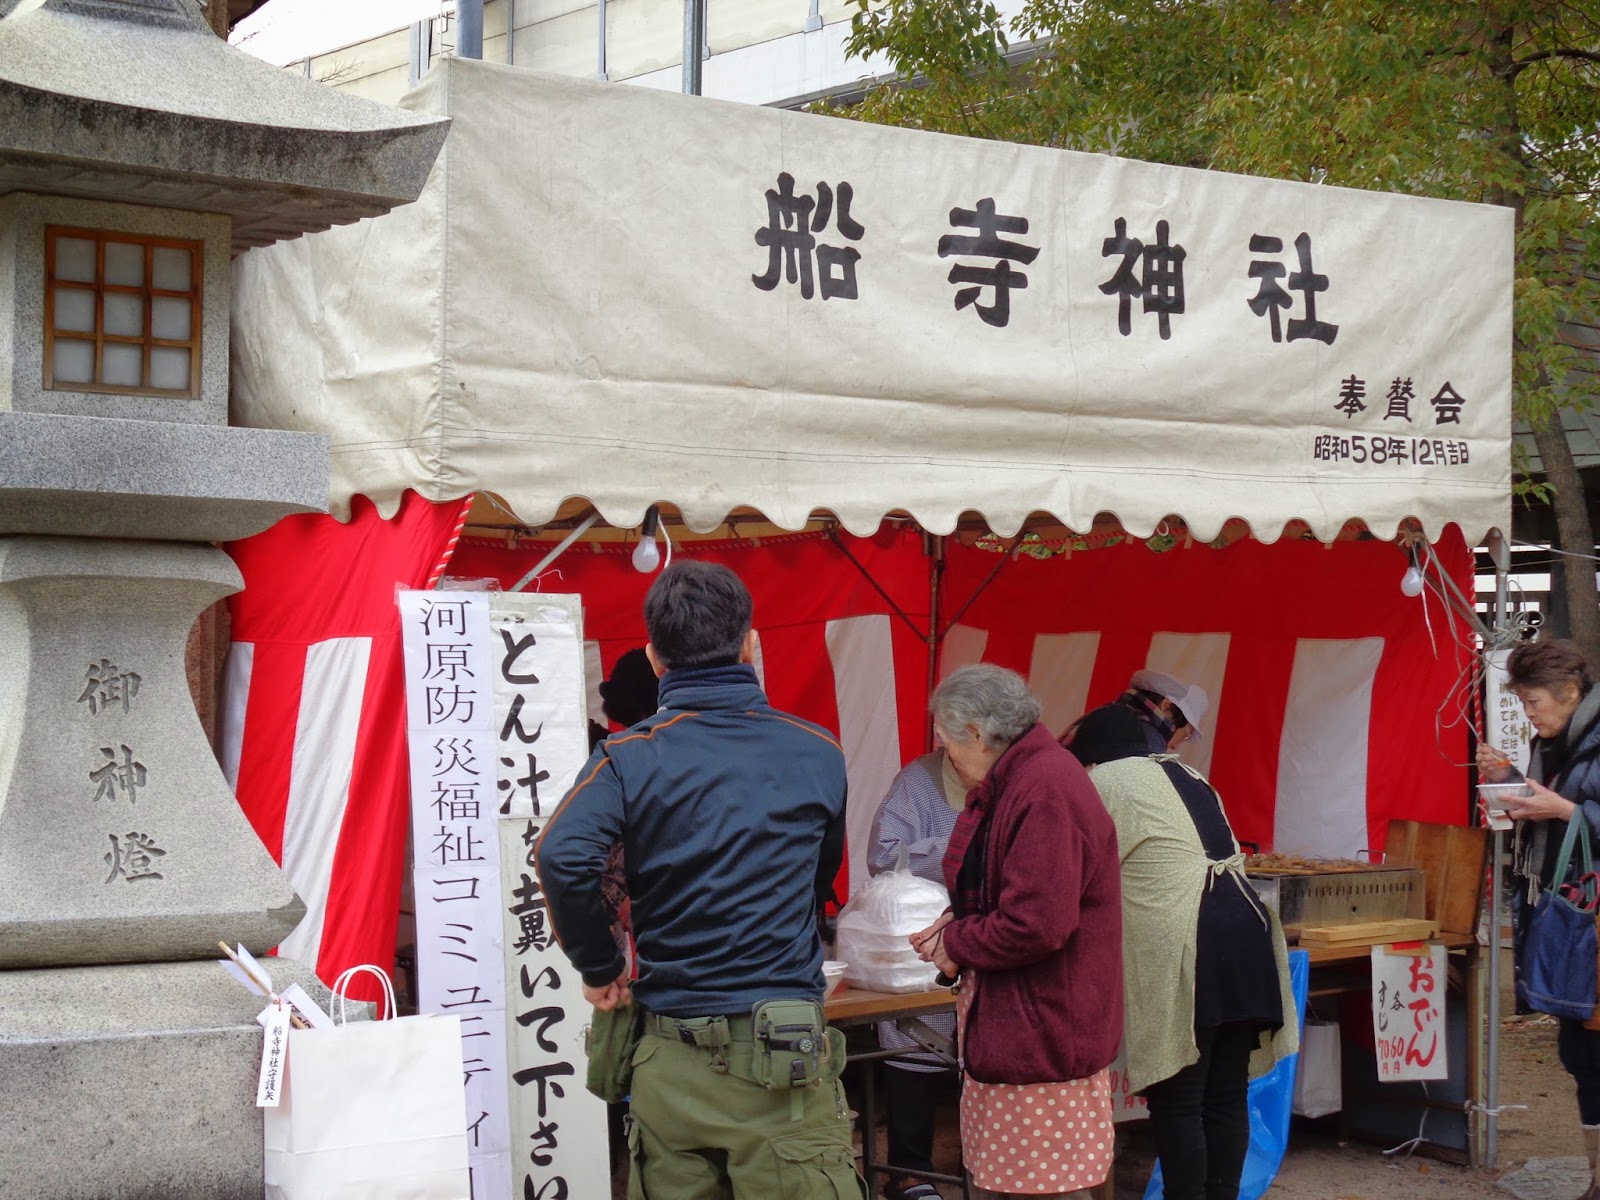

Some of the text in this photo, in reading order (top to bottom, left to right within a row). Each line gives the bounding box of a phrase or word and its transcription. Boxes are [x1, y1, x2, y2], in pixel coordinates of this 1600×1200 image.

[752, 172, 1338, 345] 船寺神社
[1333, 374, 1466, 425] 奉賛会
[77, 658, 167, 884] 御神燈
[1405, 956, 1438, 1067] おでん
